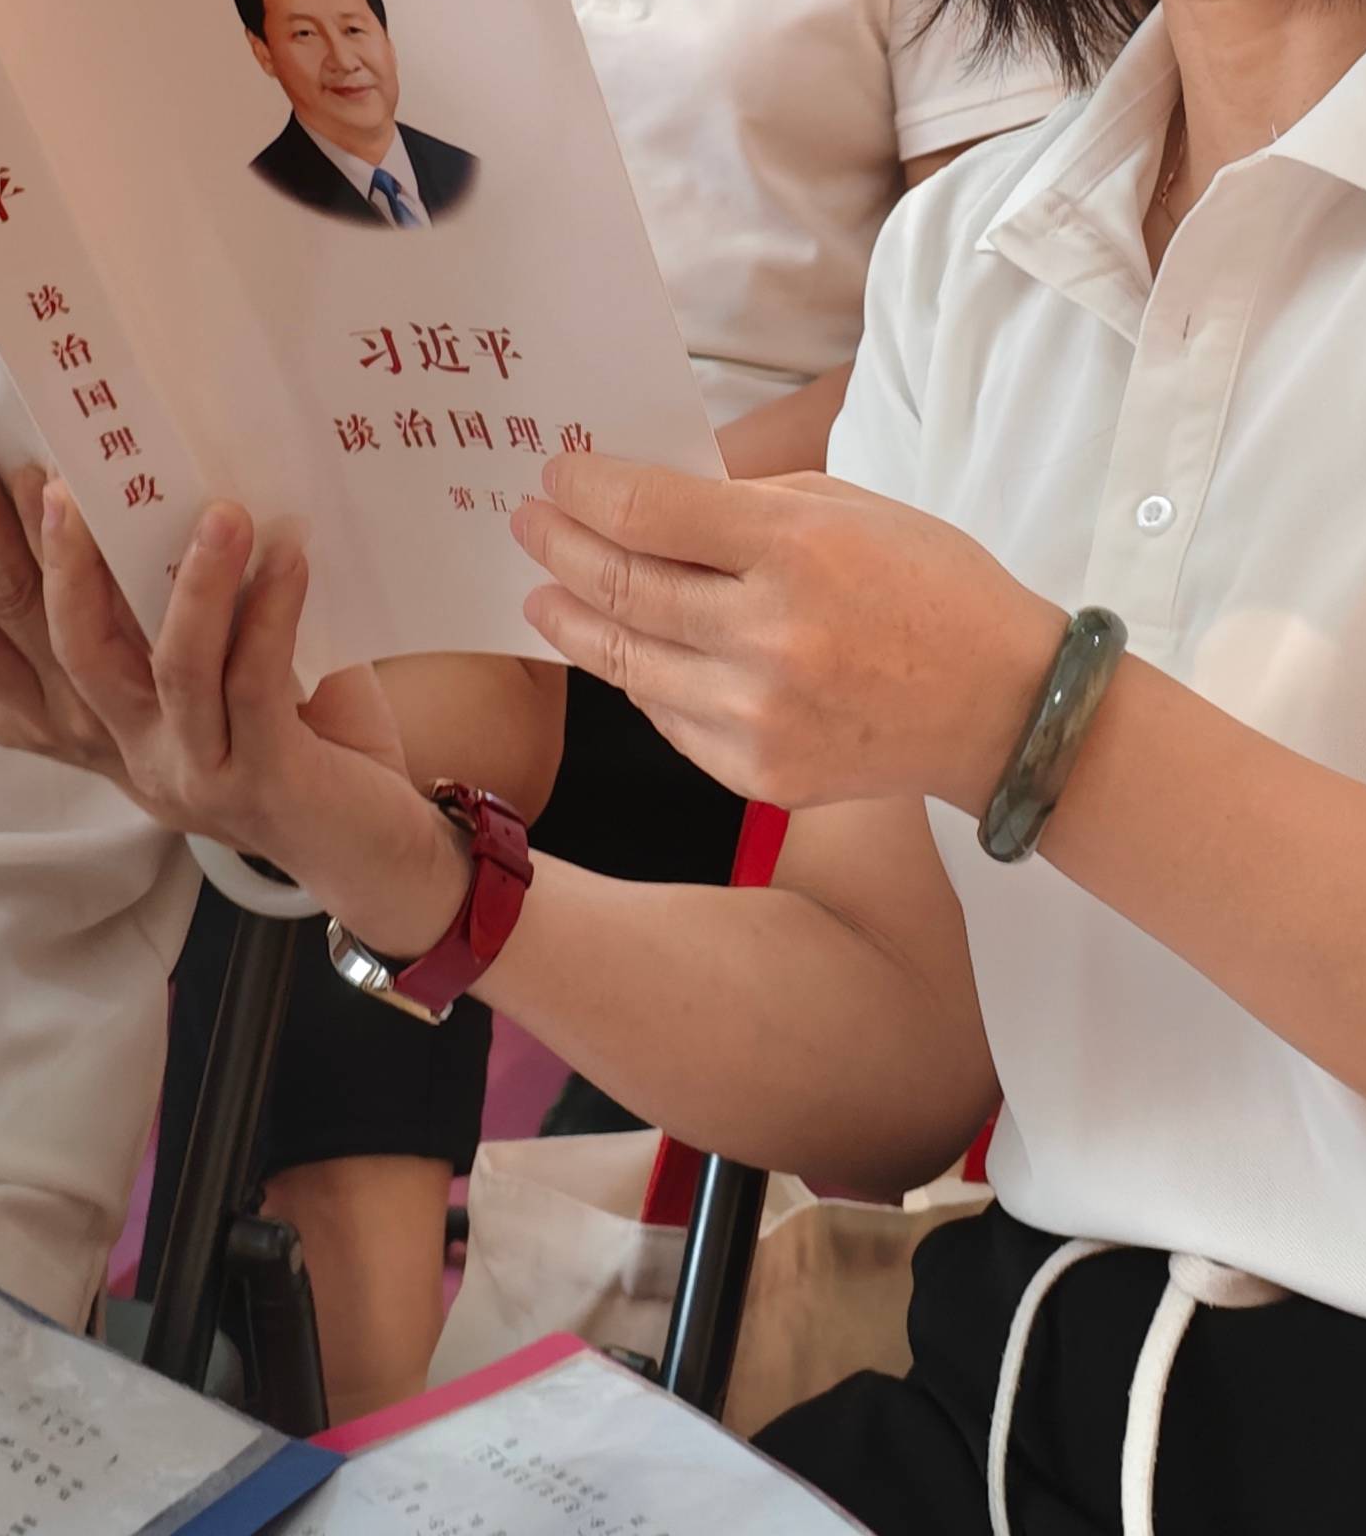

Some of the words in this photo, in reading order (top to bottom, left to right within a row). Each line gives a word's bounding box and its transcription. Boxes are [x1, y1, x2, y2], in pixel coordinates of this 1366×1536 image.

[349, 322, 522, 380] 习近平
[27, 284, 164, 507] 谈治国理政
[333, 408, 593, 454] 谈治国理政
[449, 485, 535, 512] 第五
